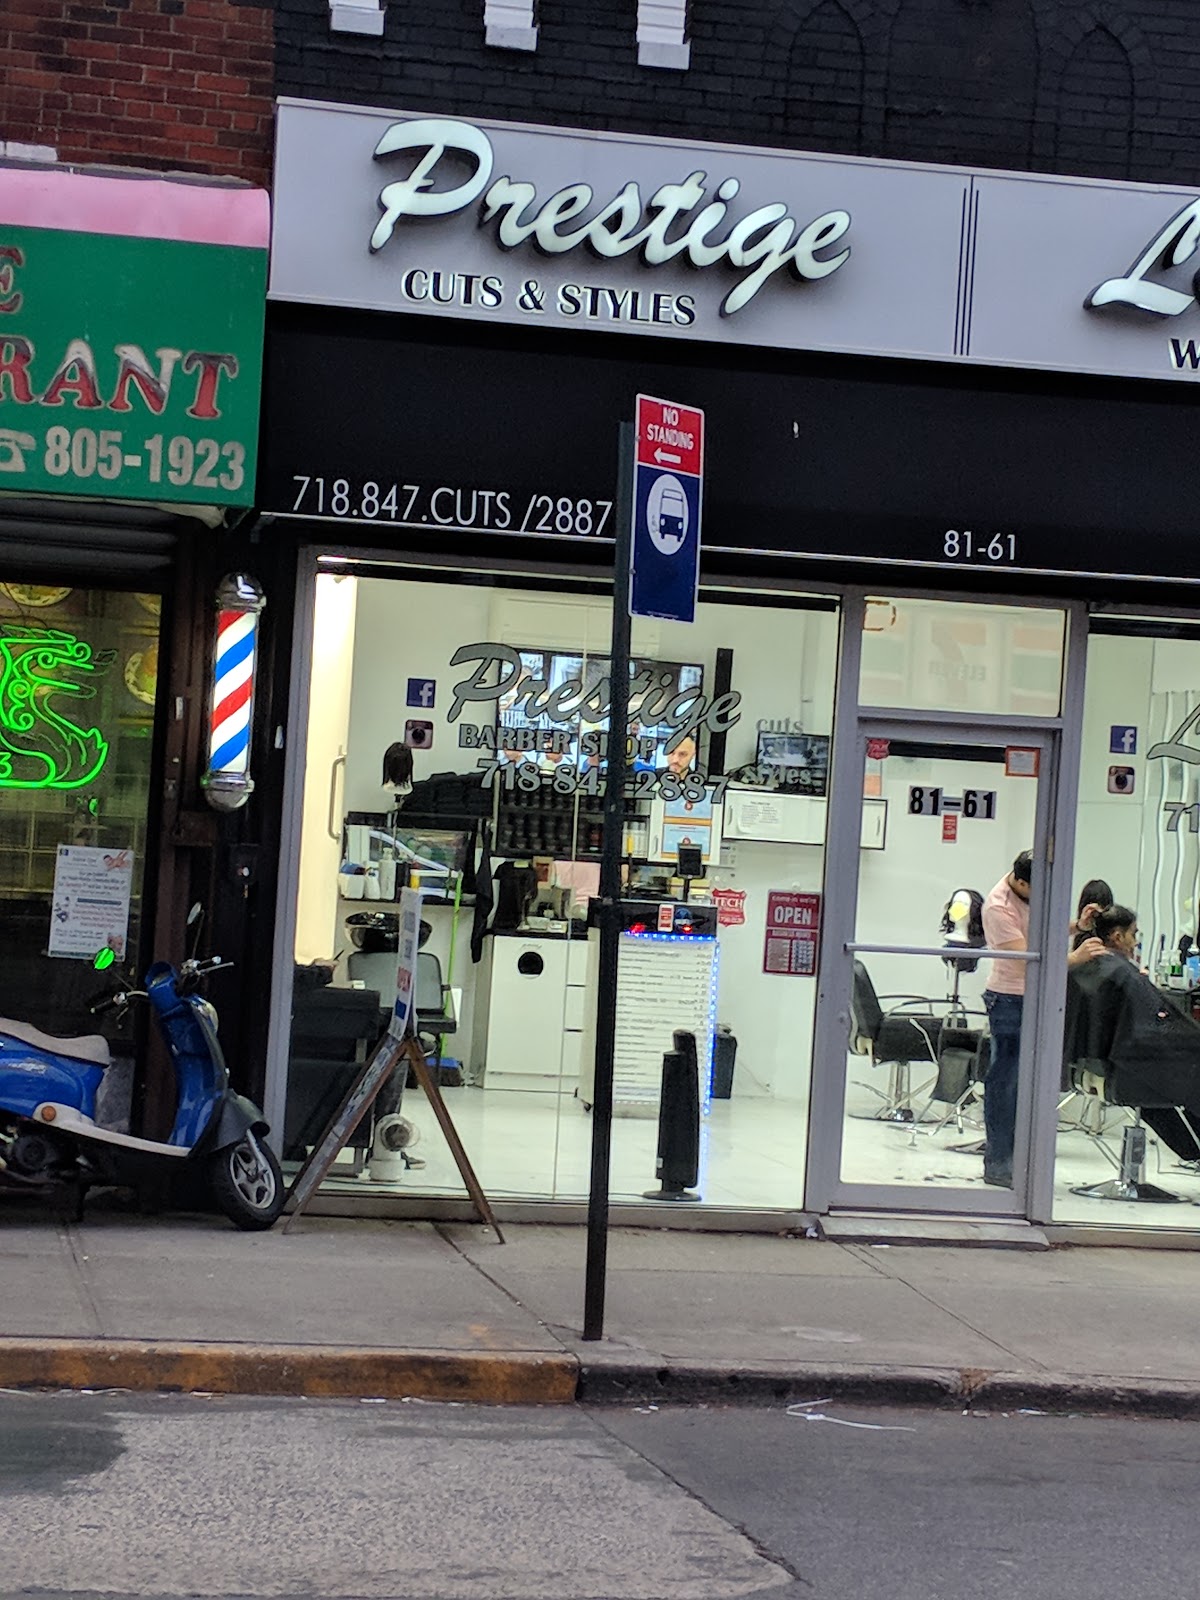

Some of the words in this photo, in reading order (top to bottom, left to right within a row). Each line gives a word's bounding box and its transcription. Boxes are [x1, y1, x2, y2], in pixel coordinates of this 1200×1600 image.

[369, 118, 851, 318] Prestige
[402, 268, 503, 308] CUTS
[517, 278, 546, 314] &
[557, 283, 697, 327] STYLES
[0, 334, 239, 418] RANT
[646, 423, 694, 450] STANDING
[663, 407, 679, 426] NO
[44, 425, 245, 490] 805-1923
[293, 475, 511, 529] 718.847.CUTS
[520, 494, 613, 536] /2887
[943, 529, 1016, 560] 81-61
[458, 723, 572, 755] BARBER
[476, 757, 730, 805] 718-84-2887
[909, 785, 995, 820] 81-61
[774, 905, 813, 926] OPEN
